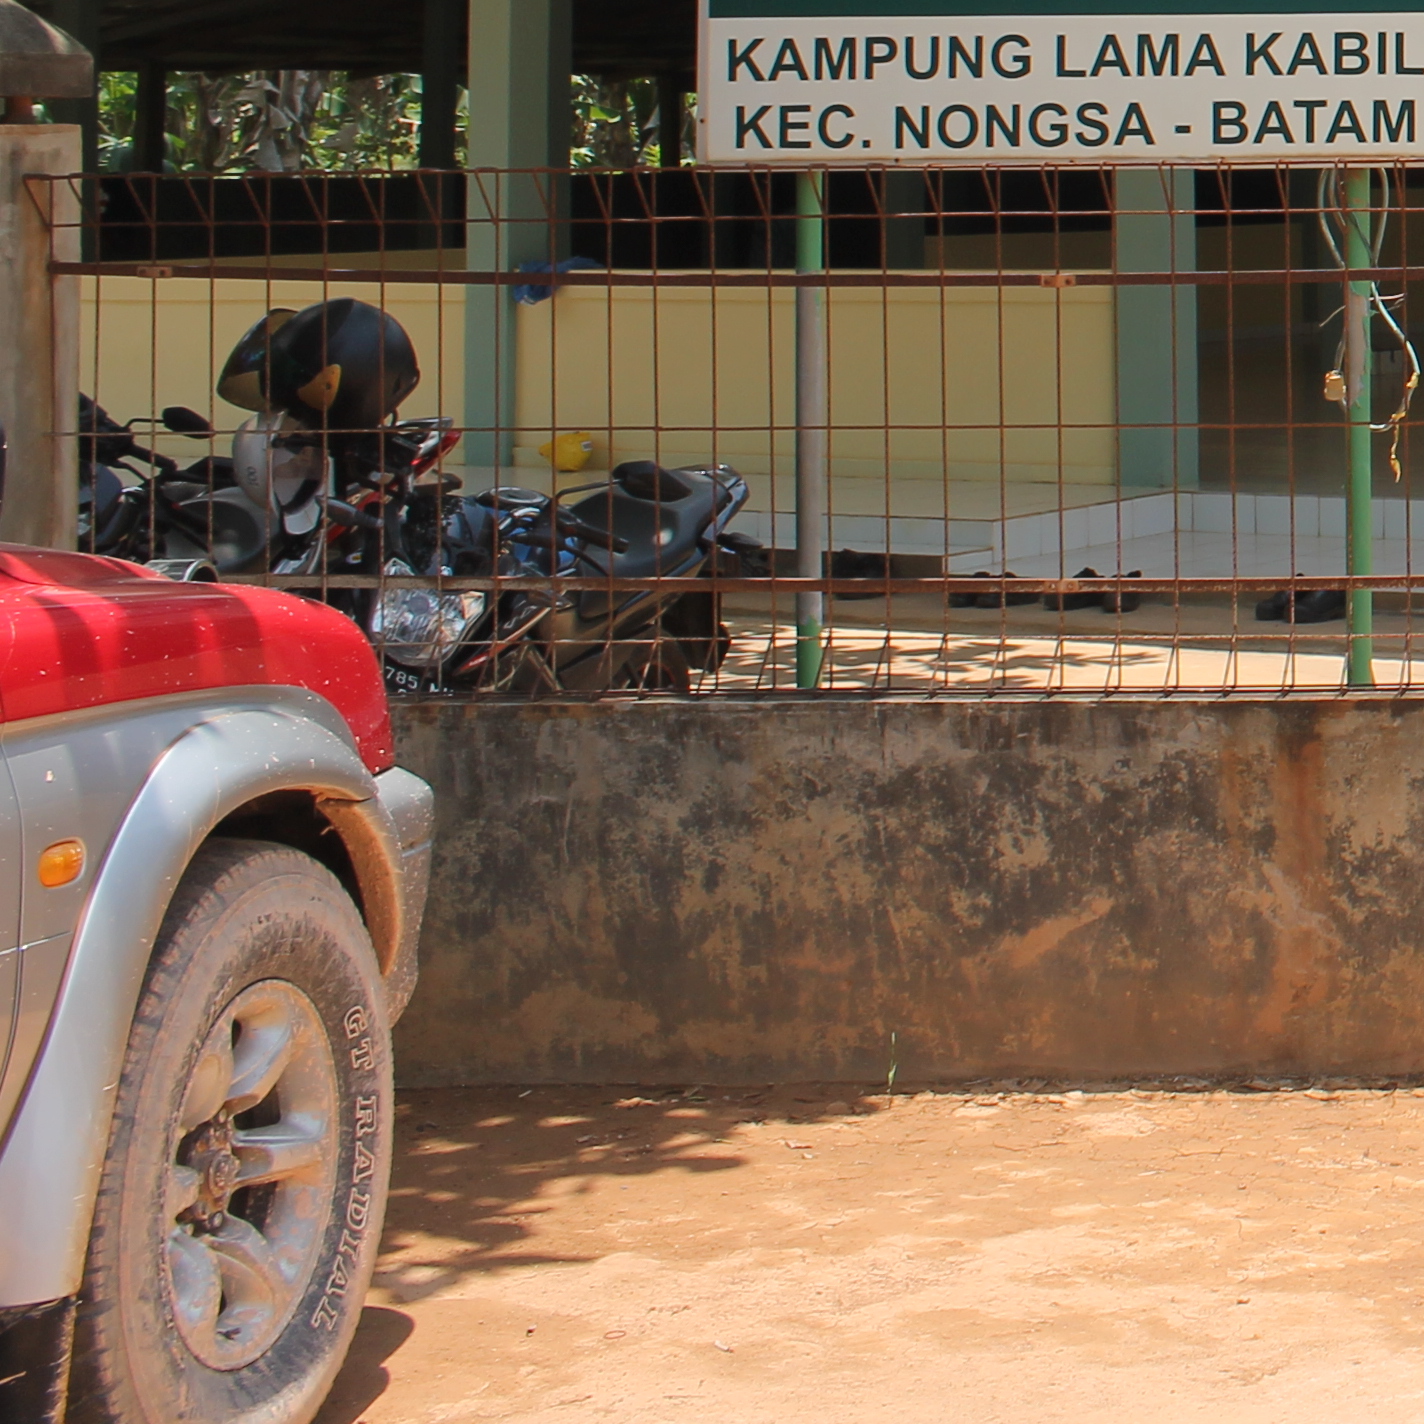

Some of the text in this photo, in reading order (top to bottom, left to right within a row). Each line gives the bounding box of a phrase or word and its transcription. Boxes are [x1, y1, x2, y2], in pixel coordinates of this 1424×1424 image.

[727, 34, 1032, 82] KAMPUNG
[1056, 33, 1226, 78] LAMA
[735, 103, 873, 149] KEC.
[895, 102, 1155, 150] NONGSA
[1212, 99, 1416, 145] BATAM
[310, 1005, 378, 1332] GT RADIAL
